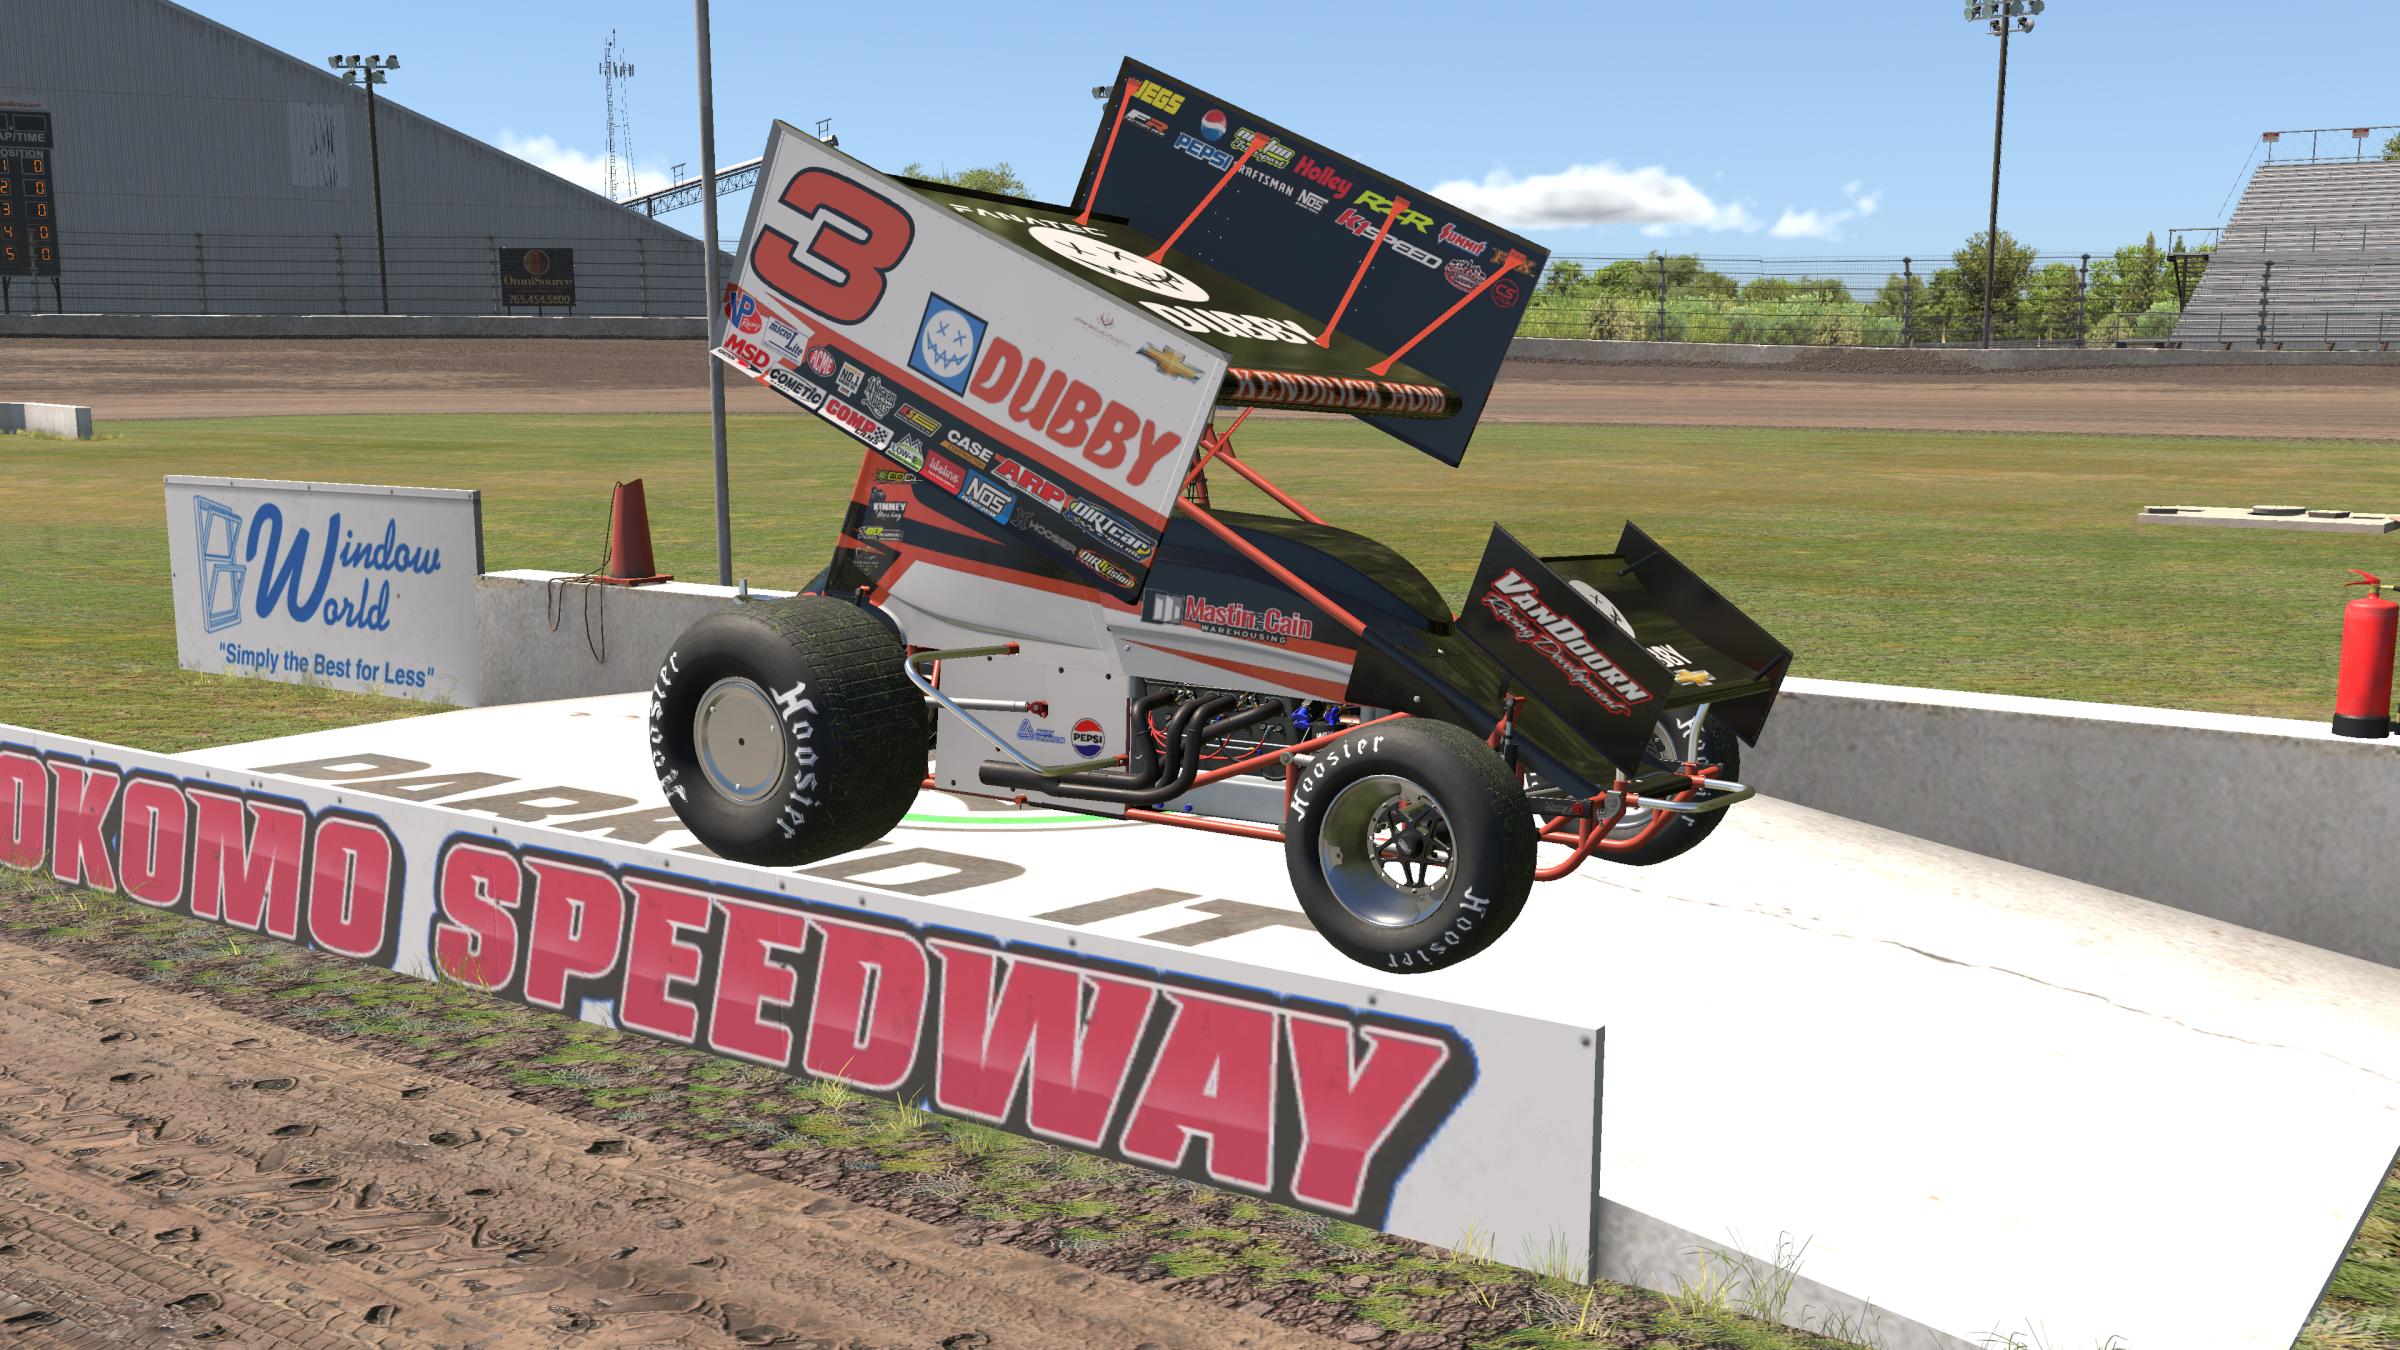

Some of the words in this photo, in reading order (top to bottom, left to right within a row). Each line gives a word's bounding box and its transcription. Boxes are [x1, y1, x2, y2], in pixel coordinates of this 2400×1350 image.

[1133, 80, 1186, 115] JEGS
[34, 160, 43, 172] 0
[1174, 132, 1234, 172] PEPSI
[0, 181, 8, 193] 2
[36, 181, 45, 195] 0
[1233, 161, 1294, 197] RAFTSMAN
[1293, 154, 1352, 199] Holley
[3, 203, 11, 215] 3
[38, 203, 47, 216] 0
[1297, 189, 1330, 211] NOS
[4, 226, 12, 237] 4
[40, 226, 48, 238] 0
[949, 204, 1108, 238] FANATEC
[6, 248, 15, 260] 5
[41, 248, 50, 260] 0
[750, 166, 916, 327] 3
[504, 275, 572, 286] OmniSource
[729, 291, 756, 329] VP
[1139, 301, 1319, 345] DUBBY
[724, 334, 770, 368] MSD
[810, 349, 833, 374] ACME
[1228, 367, 1380, 410] KENDRICK
[825, 399, 878, 433] COMP
[970, 337, 1181, 487] DUBBY
[855, 428, 879, 446] CAMS
[947, 429, 994, 463] CASE
[966, 477, 1011, 514] NOS
[996, 459, 1066, 503] ARP
[1030, 520, 1077, 555] HOOSIER
[246, 502, 441, 622] Window
[1185, 595, 1257, 629] Mastin
[1264, 607, 1313, 639] Cain
[1201, 624, 1287, 643] WAREHOUSING
[219, 642, 280, 674] "Simply
[283, 650, 309, 673] the
[313, 653, 352, 679] Best
[356, 659, 381, 682] for
[383, 662, 436, 689] Less"
[1488, 594, 1535, 639] Racing
[1534, 634, 1629, 710] Development
[1073, 732, 1103, 744] PEPSI
[769, 681, 822, 839] Hoosier
[1290, 734, 1385, 822] Hoosier
[1028, 887, 1320, 948] IT
[1388, 885, 1492, 968] Hoosier
[434, 842, 1452, 1216] SPEEDWAY
